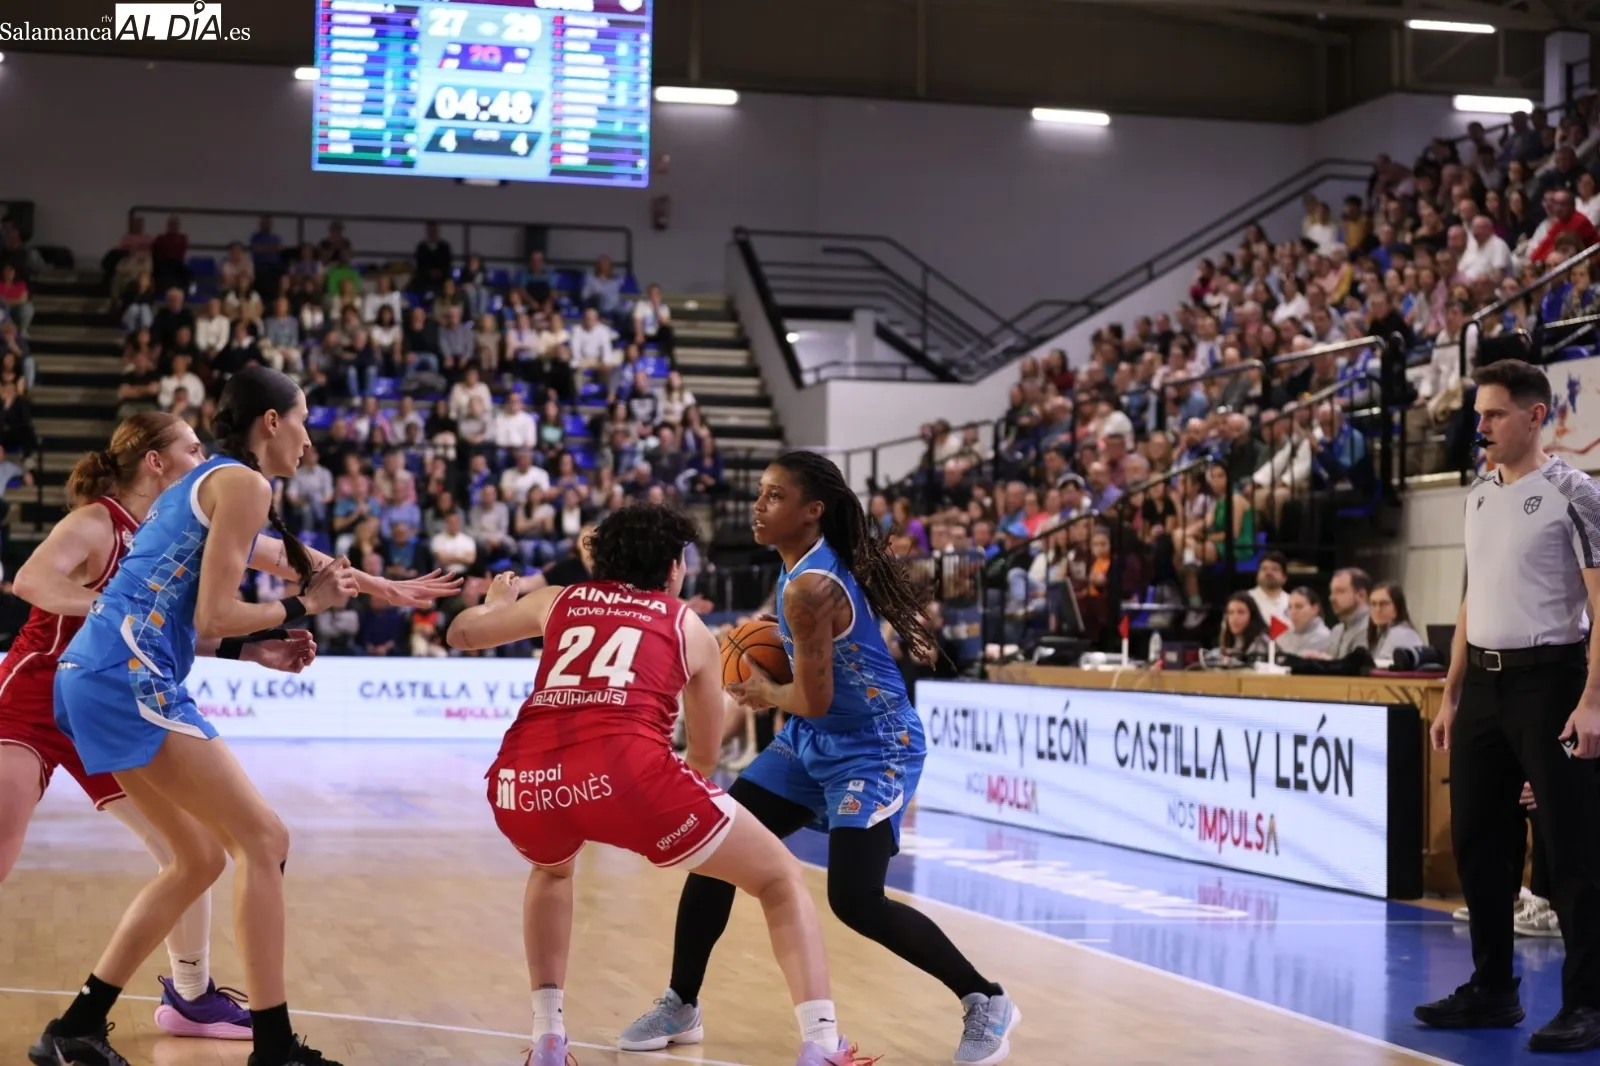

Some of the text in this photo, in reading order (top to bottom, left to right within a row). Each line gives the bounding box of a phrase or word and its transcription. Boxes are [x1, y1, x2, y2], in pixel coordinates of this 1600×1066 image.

[435, 86, 533, 124] 04:48
[606, 607, 652, 622] Home
[545, 626, 643, 689] 24
[226, 678, 242, 701] Y
[252, 674, 315, 698] LEÓN
[359, 681, 535, 702] CASTILLA Y LE
[530, 688, 627, 706] BAUHAUS
[930, 699, 1088, 768] CASTILLA Y LEÓN
[519, 764, 562, 784] espai
[1114, 713, 1353, 799] CASTILLA Y LEÓN
[519, 773, 612, 812] GIRONÈS
[1167, 800, 1279, 856] NOS IMPULSA
